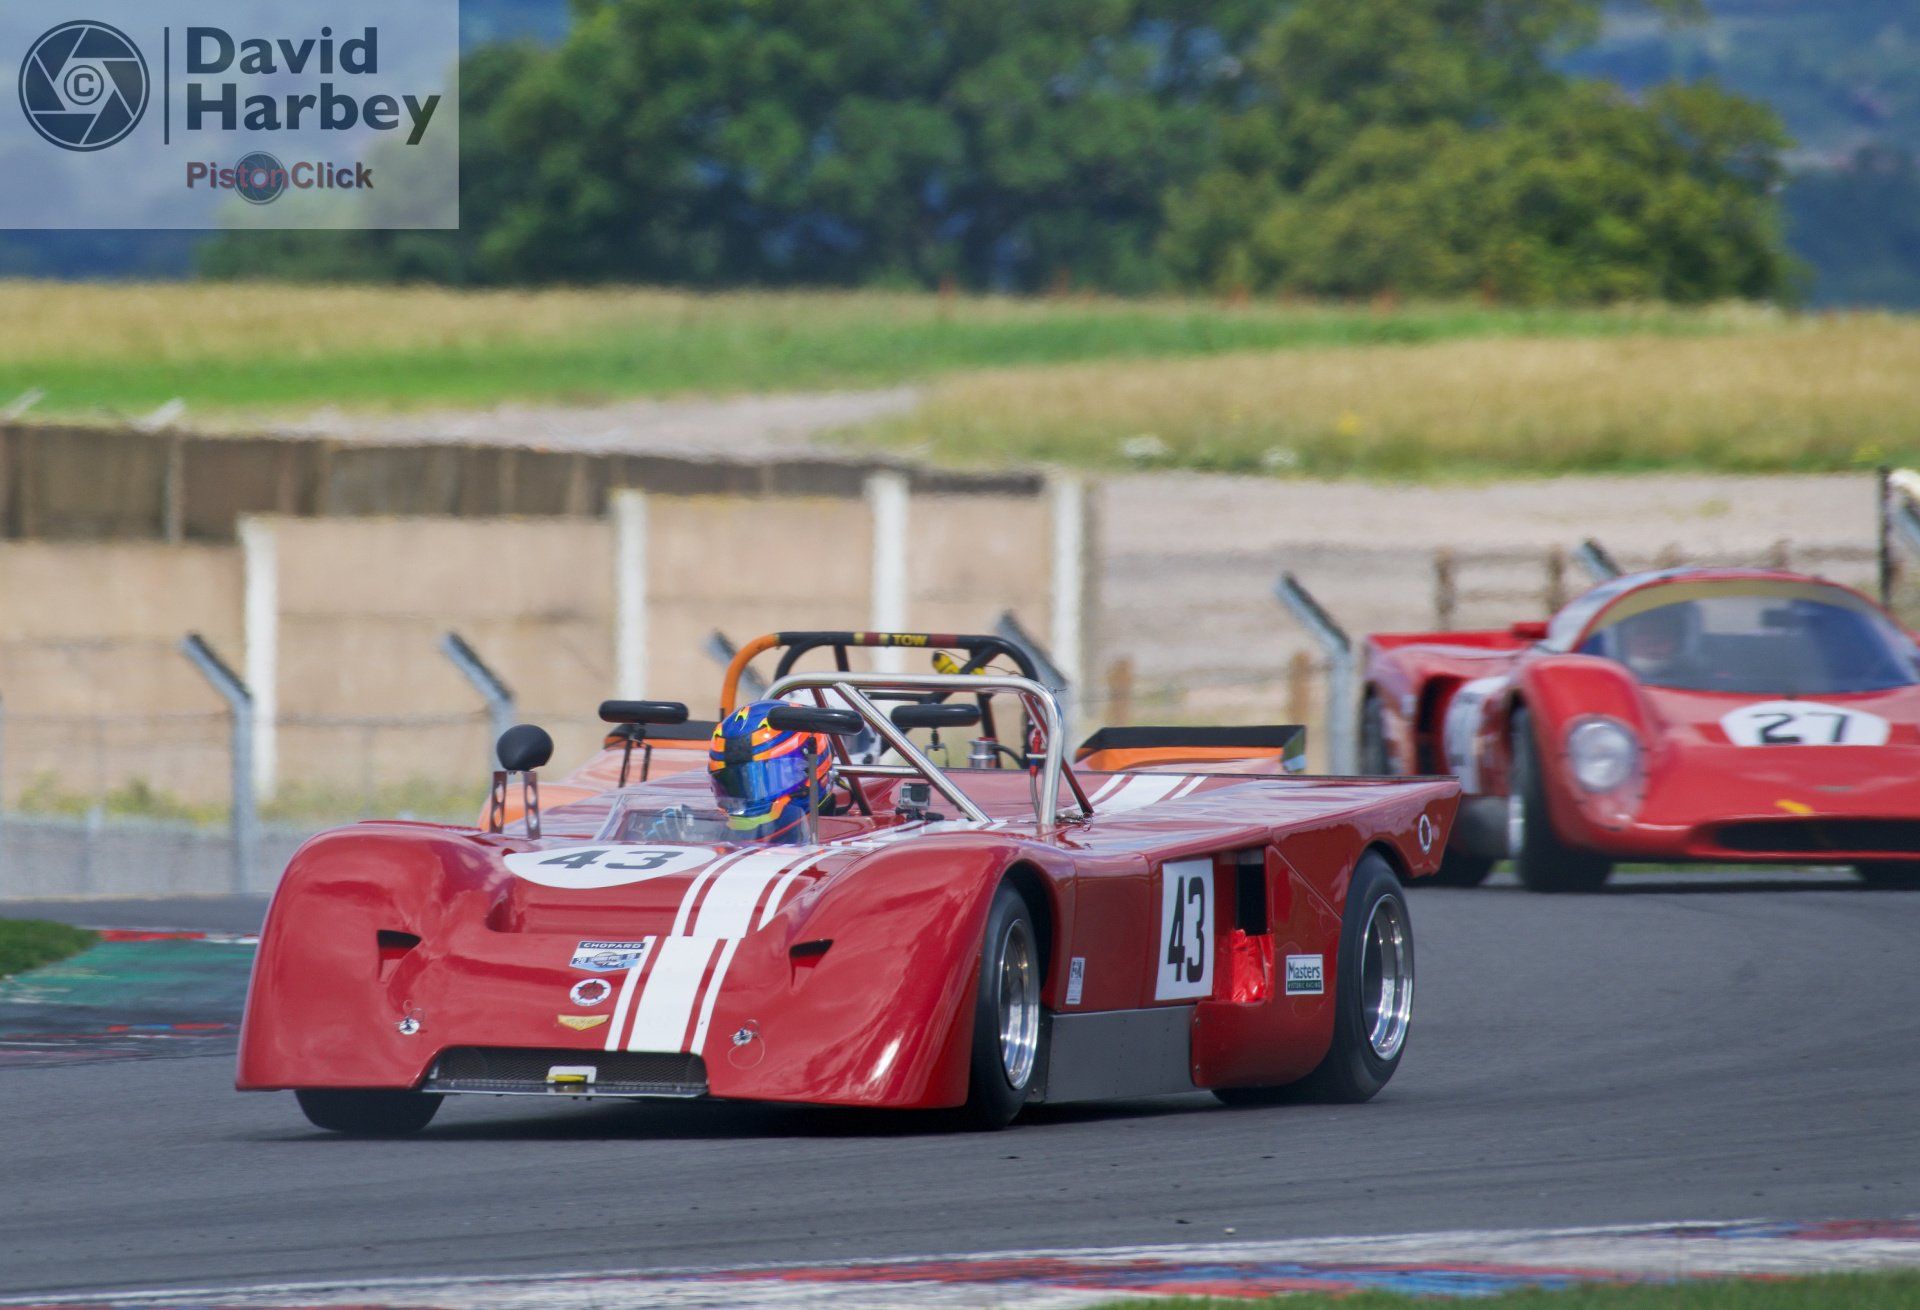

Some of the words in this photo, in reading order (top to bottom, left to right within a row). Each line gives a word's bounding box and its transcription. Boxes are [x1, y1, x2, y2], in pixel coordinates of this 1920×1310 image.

[892, 634, 928, 646] TOW
[1751, 712, 1849, 744] 27
[538, 850, 684, 870] 43
[1167, 875, 1205, 983] 43
[1288, 961, 1321, 979] Masters
